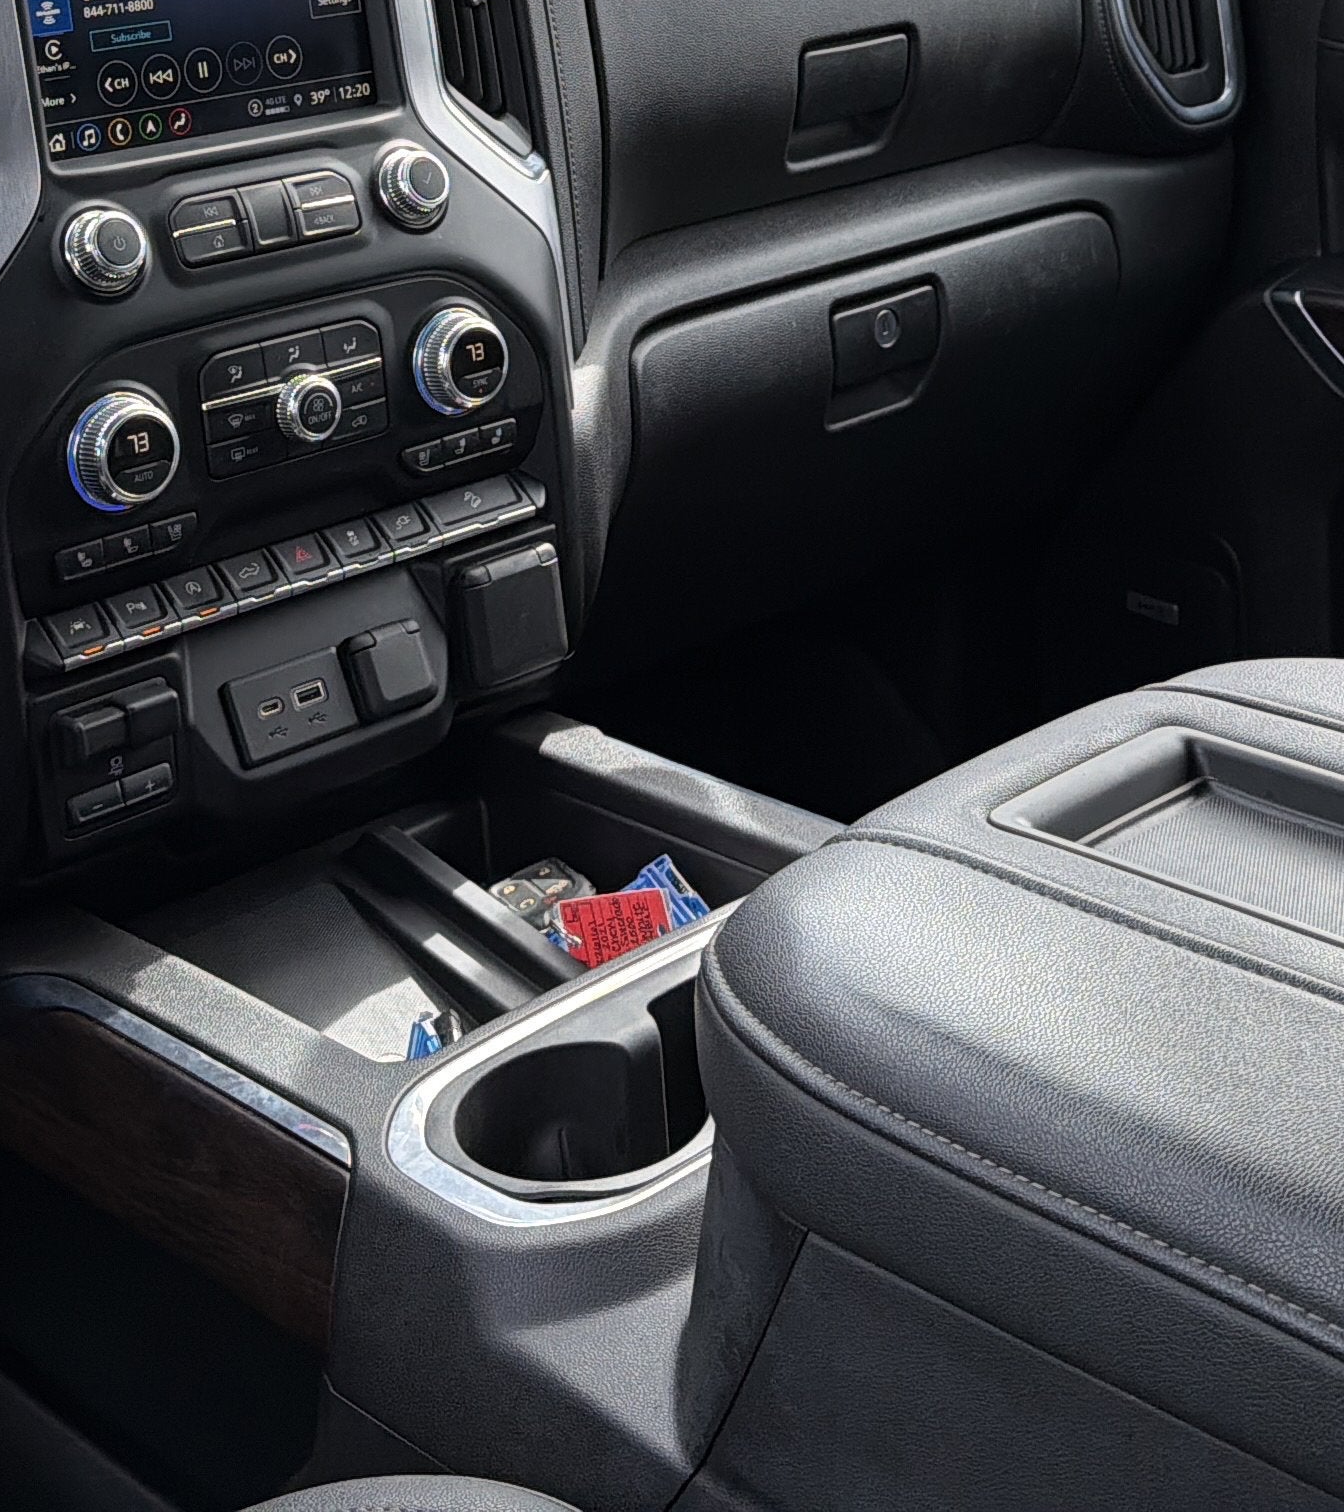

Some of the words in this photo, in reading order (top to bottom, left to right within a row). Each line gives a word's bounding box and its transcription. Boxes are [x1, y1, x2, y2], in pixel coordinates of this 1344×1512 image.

[110, 29, 152, 44] Subscribe
[273, 52, 288, 64] CH
[113, 77, 130, 90] CH
[338, 82, 371, 100] 12:20
[465, 342, 485, 362] 73
[351, 382, 364, 394] A/C
[308, 411, 333, 425] ON/OFF
[126, 431, 150, 454] 73
[133, 470, 154, 483] AUTO
